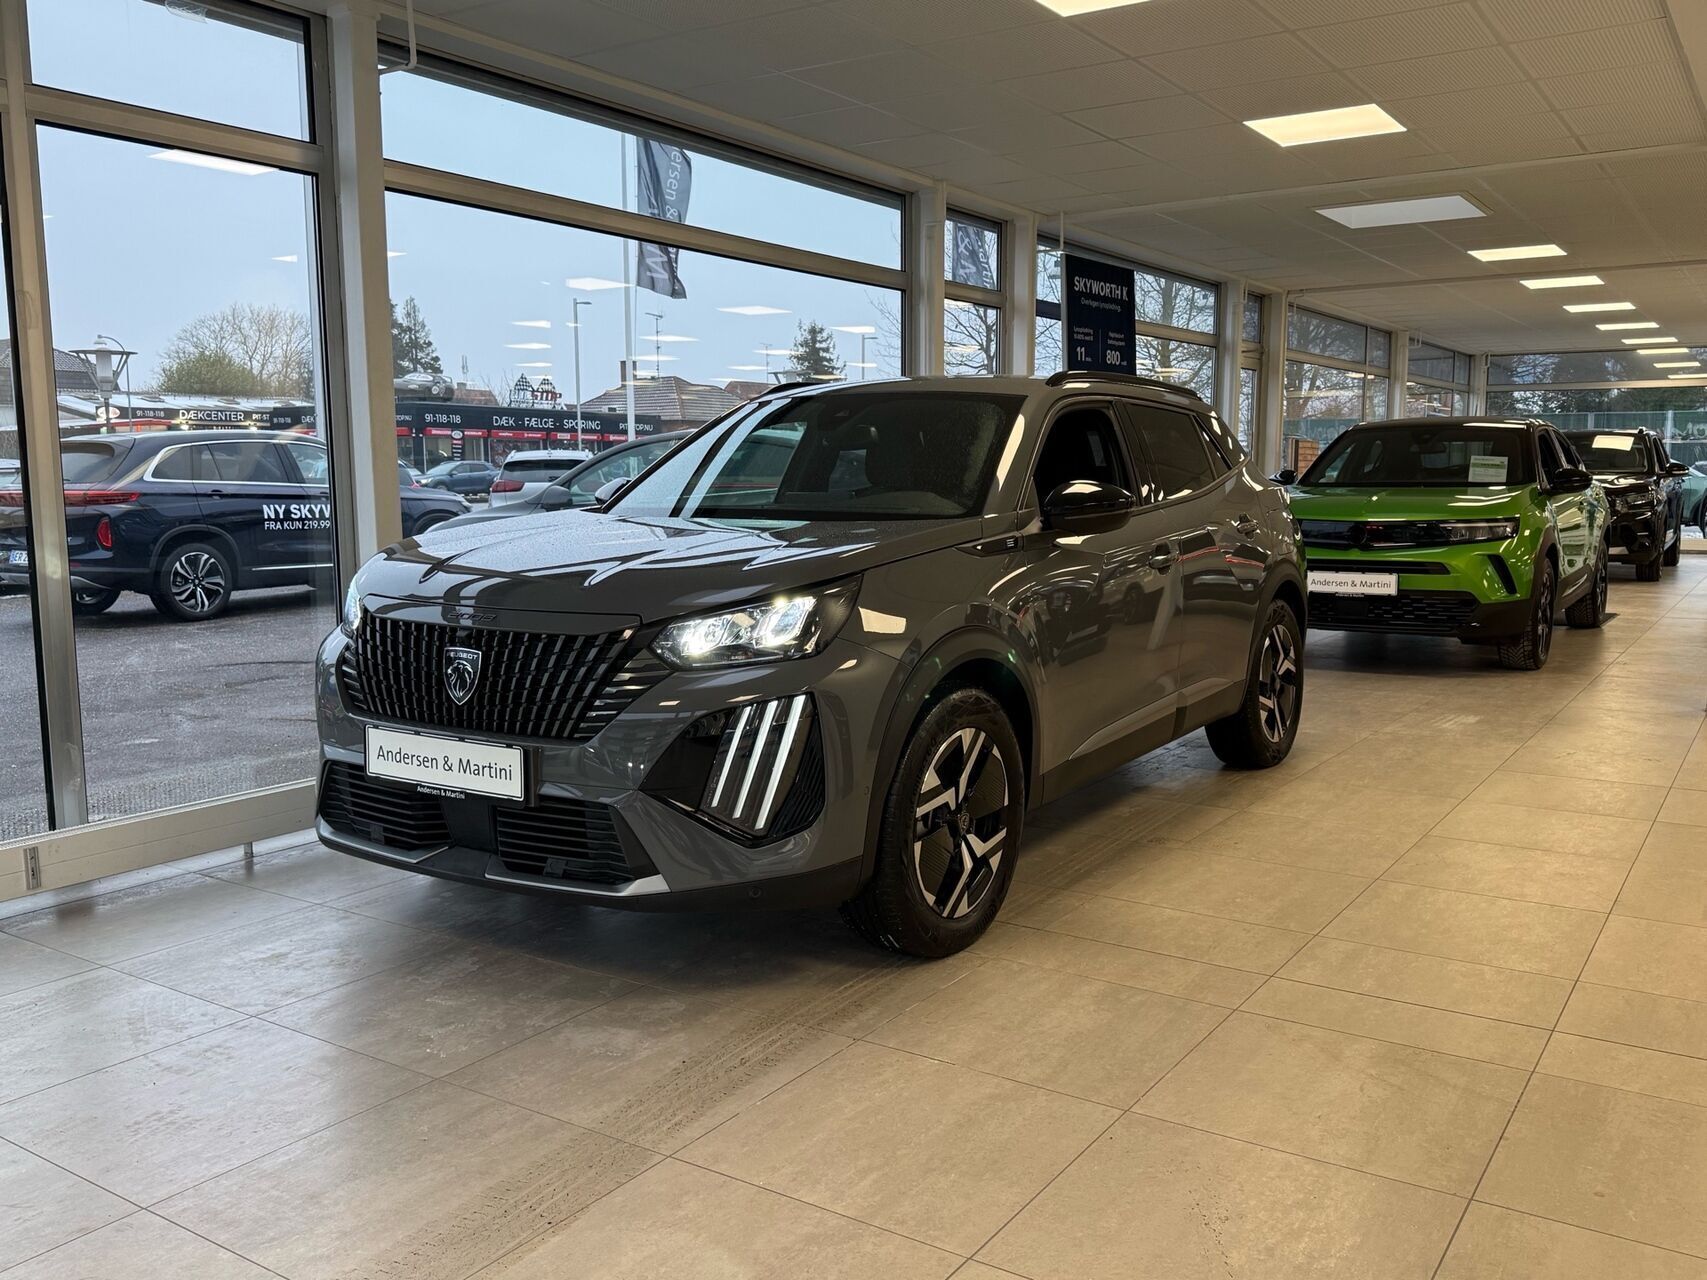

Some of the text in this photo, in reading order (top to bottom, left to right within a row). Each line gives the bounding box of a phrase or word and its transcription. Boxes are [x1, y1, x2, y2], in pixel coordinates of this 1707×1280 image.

[1074, 275, 1129, 302] SKYWORTH K
[1076, 346, 1085, 362] 11
[1106, 350, 1121, 366] 800
[179, 409, 244, 422] DÆKCENTER
[424, 413, 461, 424] 91-118-118
[492, 415, 516, 427] DÆK
[524, 417, 555, 428] FÆLGE
[262, 504, 286, 519] NY
[264, 521, 283, 531] FRA
[283, 520, 303, 530] KUN
[1310, 578, 1349, 587] Andersen
[1359, 580, 1392, 589] Martini
[377, 745, 512, 781] Andersen & Martini
[416, 785, 441, 796] Andersen
[446, 790, 465, 800] Martini
